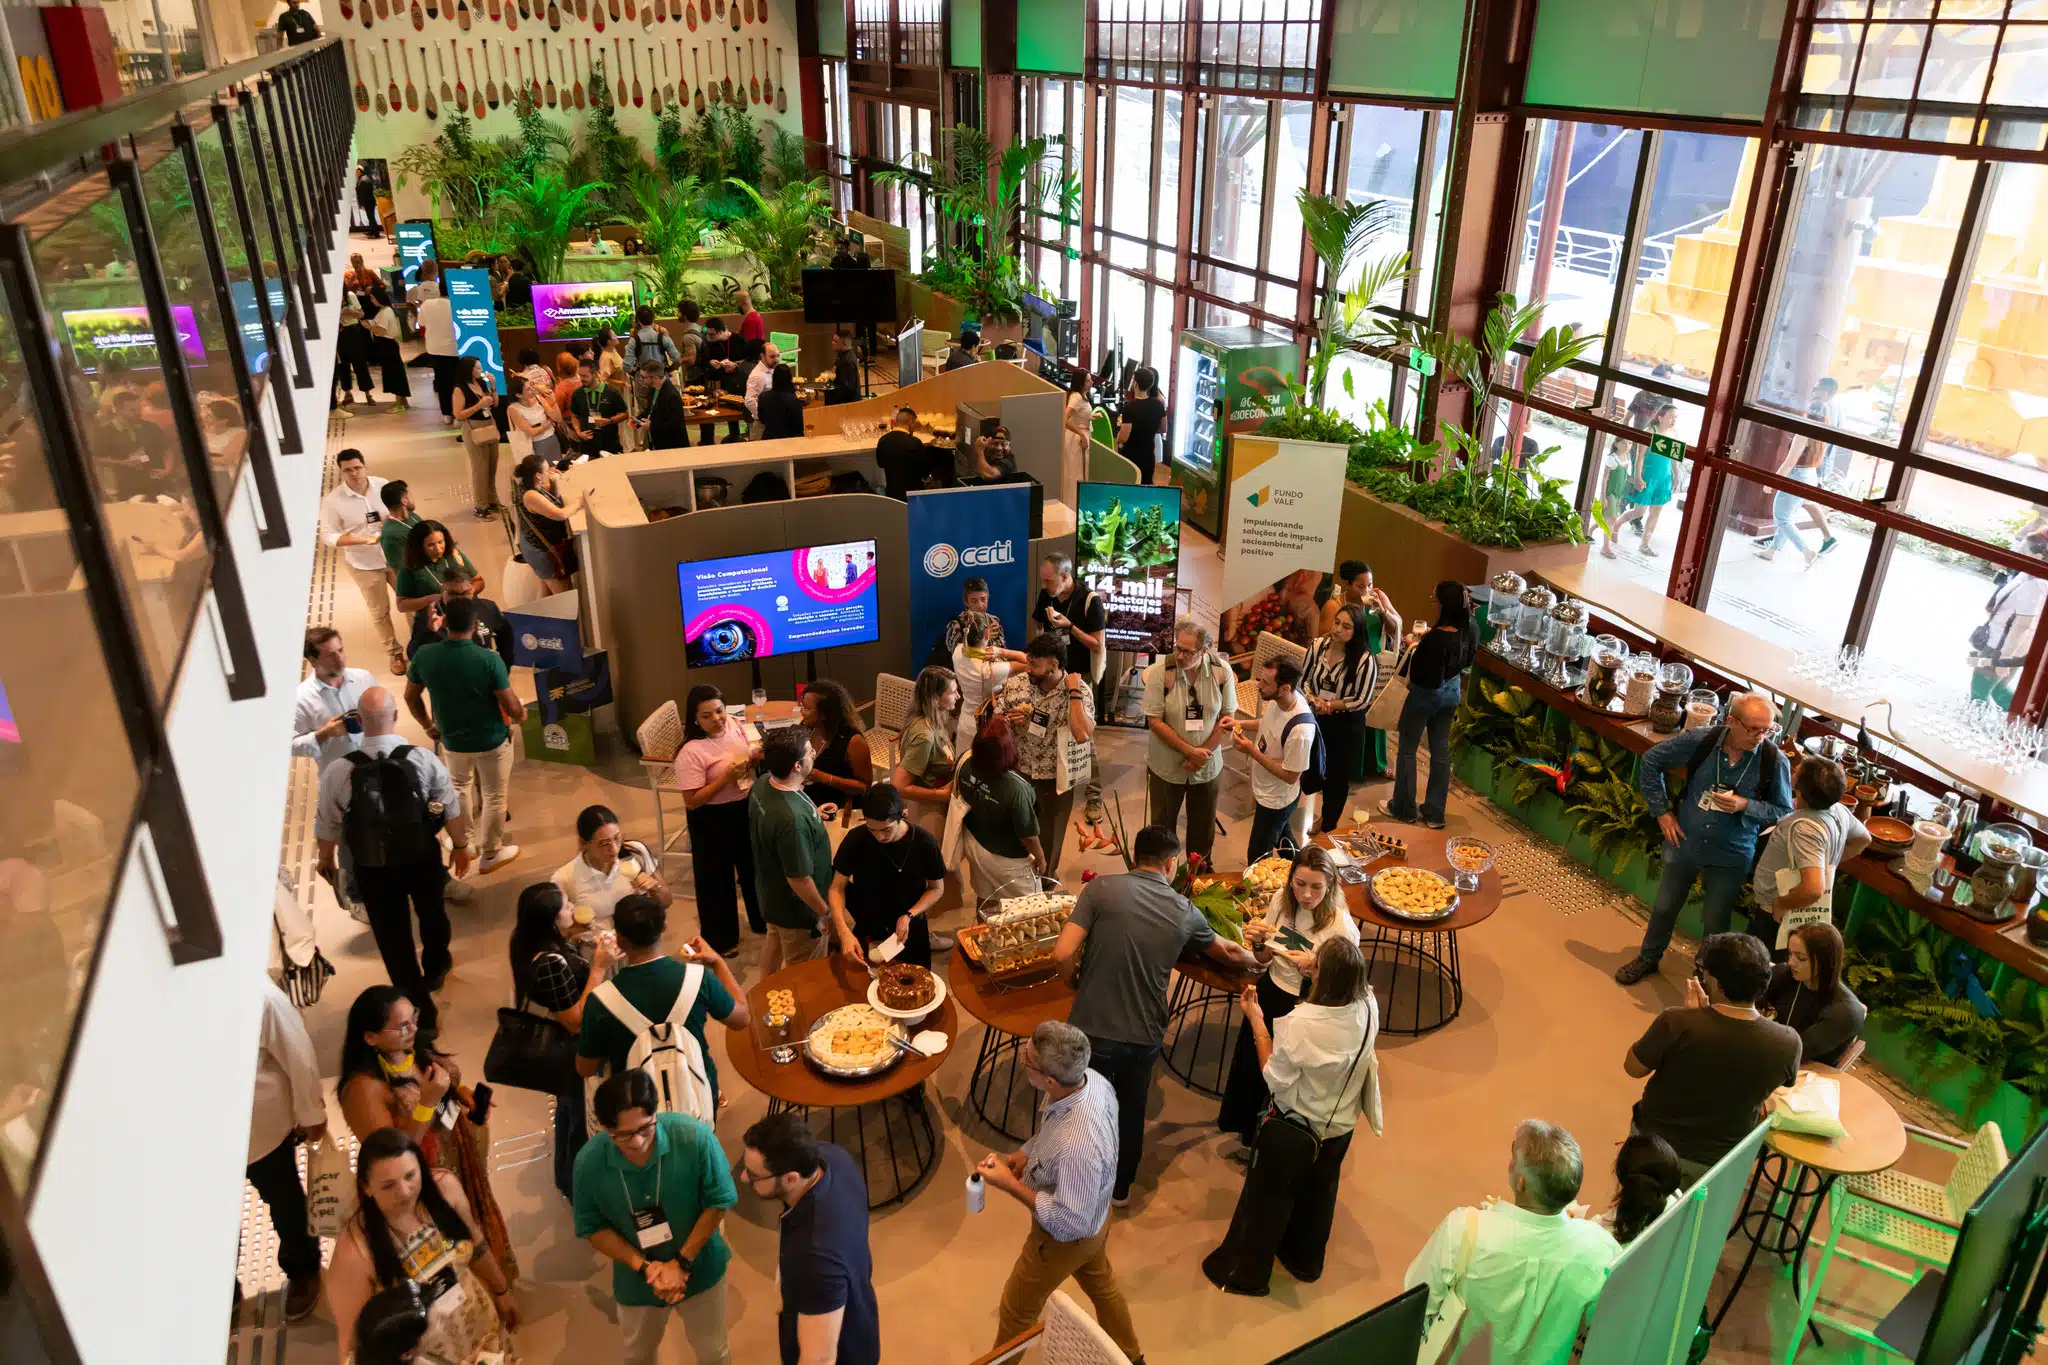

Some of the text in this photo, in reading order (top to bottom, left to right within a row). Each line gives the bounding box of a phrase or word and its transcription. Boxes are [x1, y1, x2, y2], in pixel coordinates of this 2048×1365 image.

[1274, 489, 1304, 499] FUNDO
[1273, 498, 1294, 506] VALE
[1243, 517, 1304, 530] Impulsionando
[1242, 528, 1324, 543] soluções de impacto
[1241, 538, 1304, 550] socioambiental
[1240, 547, 1274, 557] positivo
[717, 566, 769, 578] Computacional
[1087, 563, 1130, 575] Mais de
[1084, 573, 1164, 599] 14 mil
[1110, 593, 1162, 607] hectares
[1103, 601, 1162, 616] uperados
